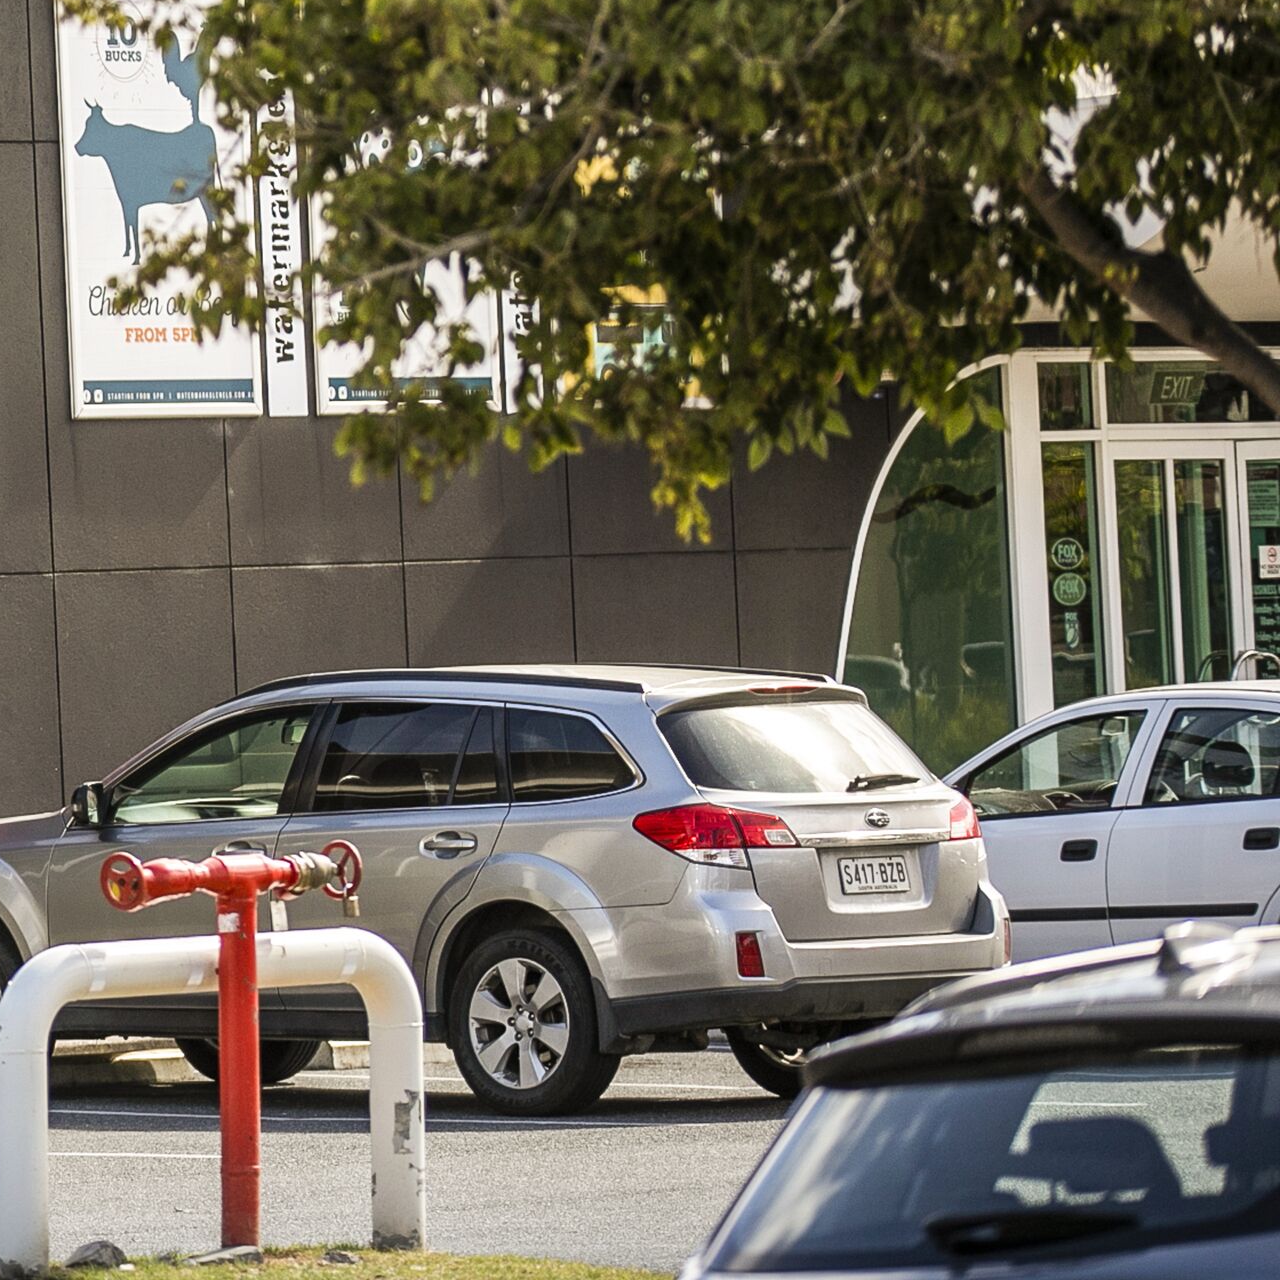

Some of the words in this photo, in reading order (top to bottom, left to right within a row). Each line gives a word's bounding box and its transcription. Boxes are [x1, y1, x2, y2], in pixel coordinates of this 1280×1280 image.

[104, 50, 142, 62] BUCKS
[125, 327, 167, 343] FROM
[1160, 375, 1195, 399] EXIT
